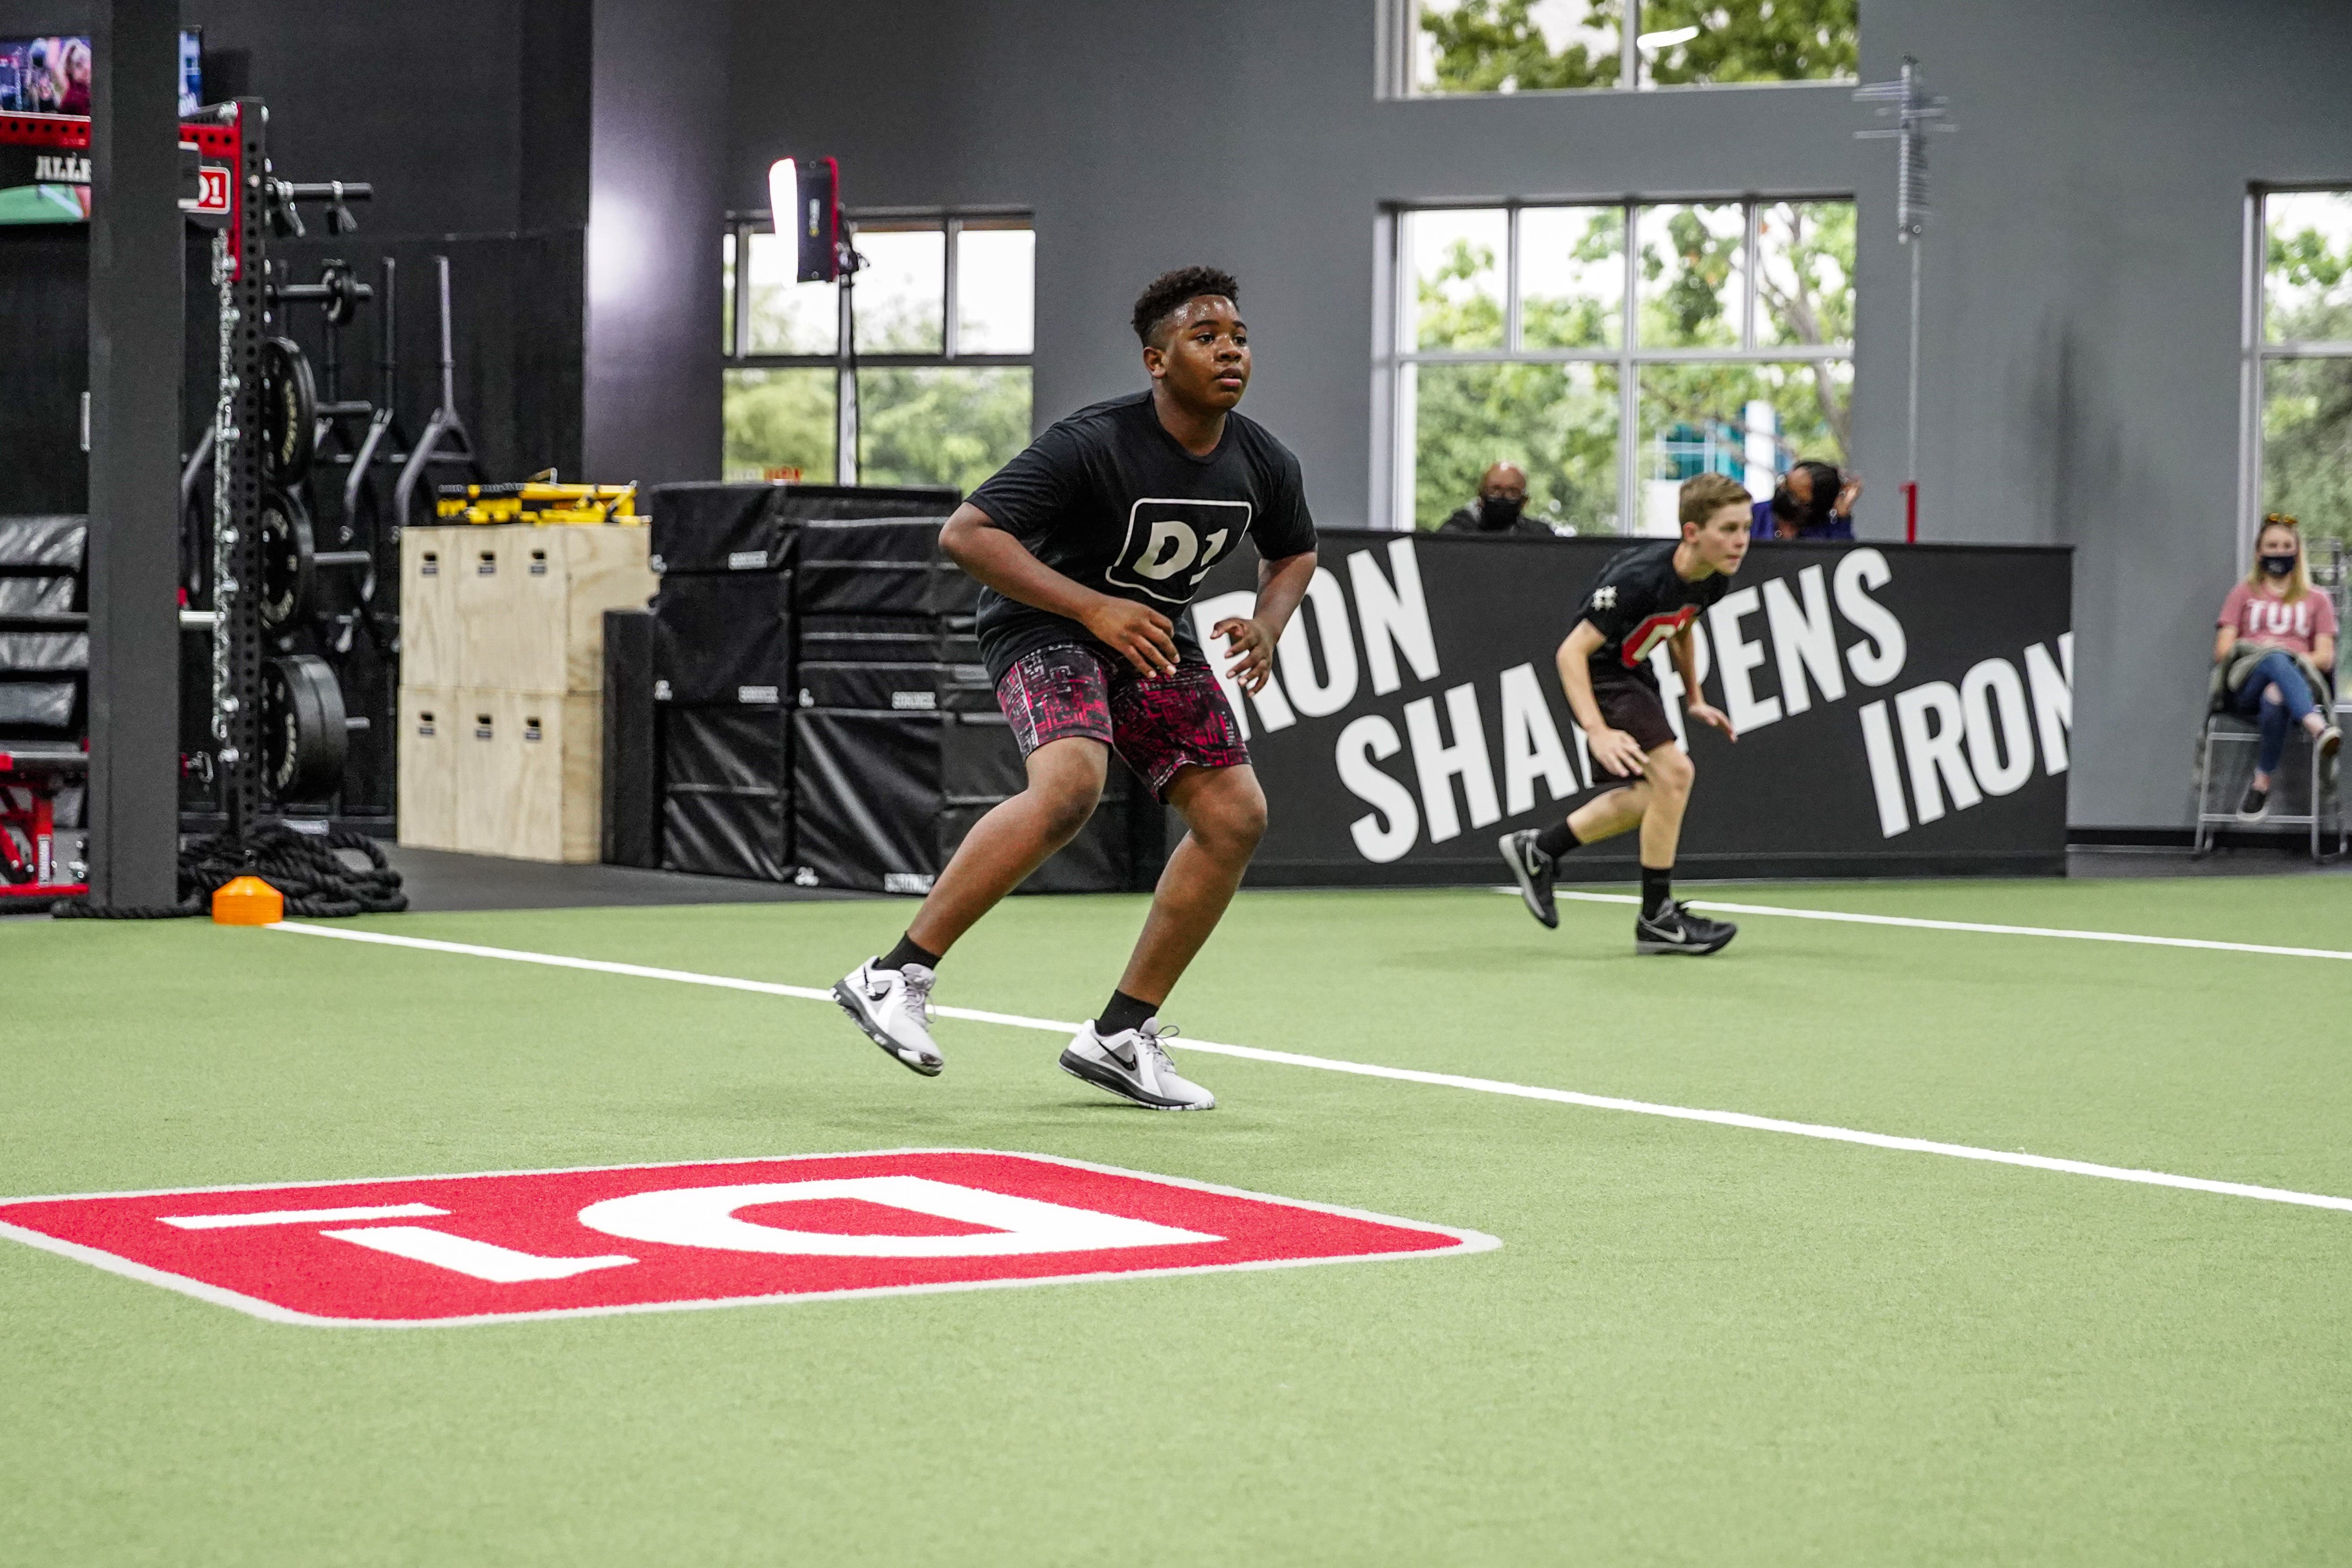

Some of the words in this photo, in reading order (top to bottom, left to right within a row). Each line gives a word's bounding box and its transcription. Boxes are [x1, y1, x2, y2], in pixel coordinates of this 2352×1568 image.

[1133, 520, 1228, 585] D1
[1191, 536, 1441, 741] RON
[1858, 631, 2074, 838] IRON
[155, 1174, 1229, 1283] D1
